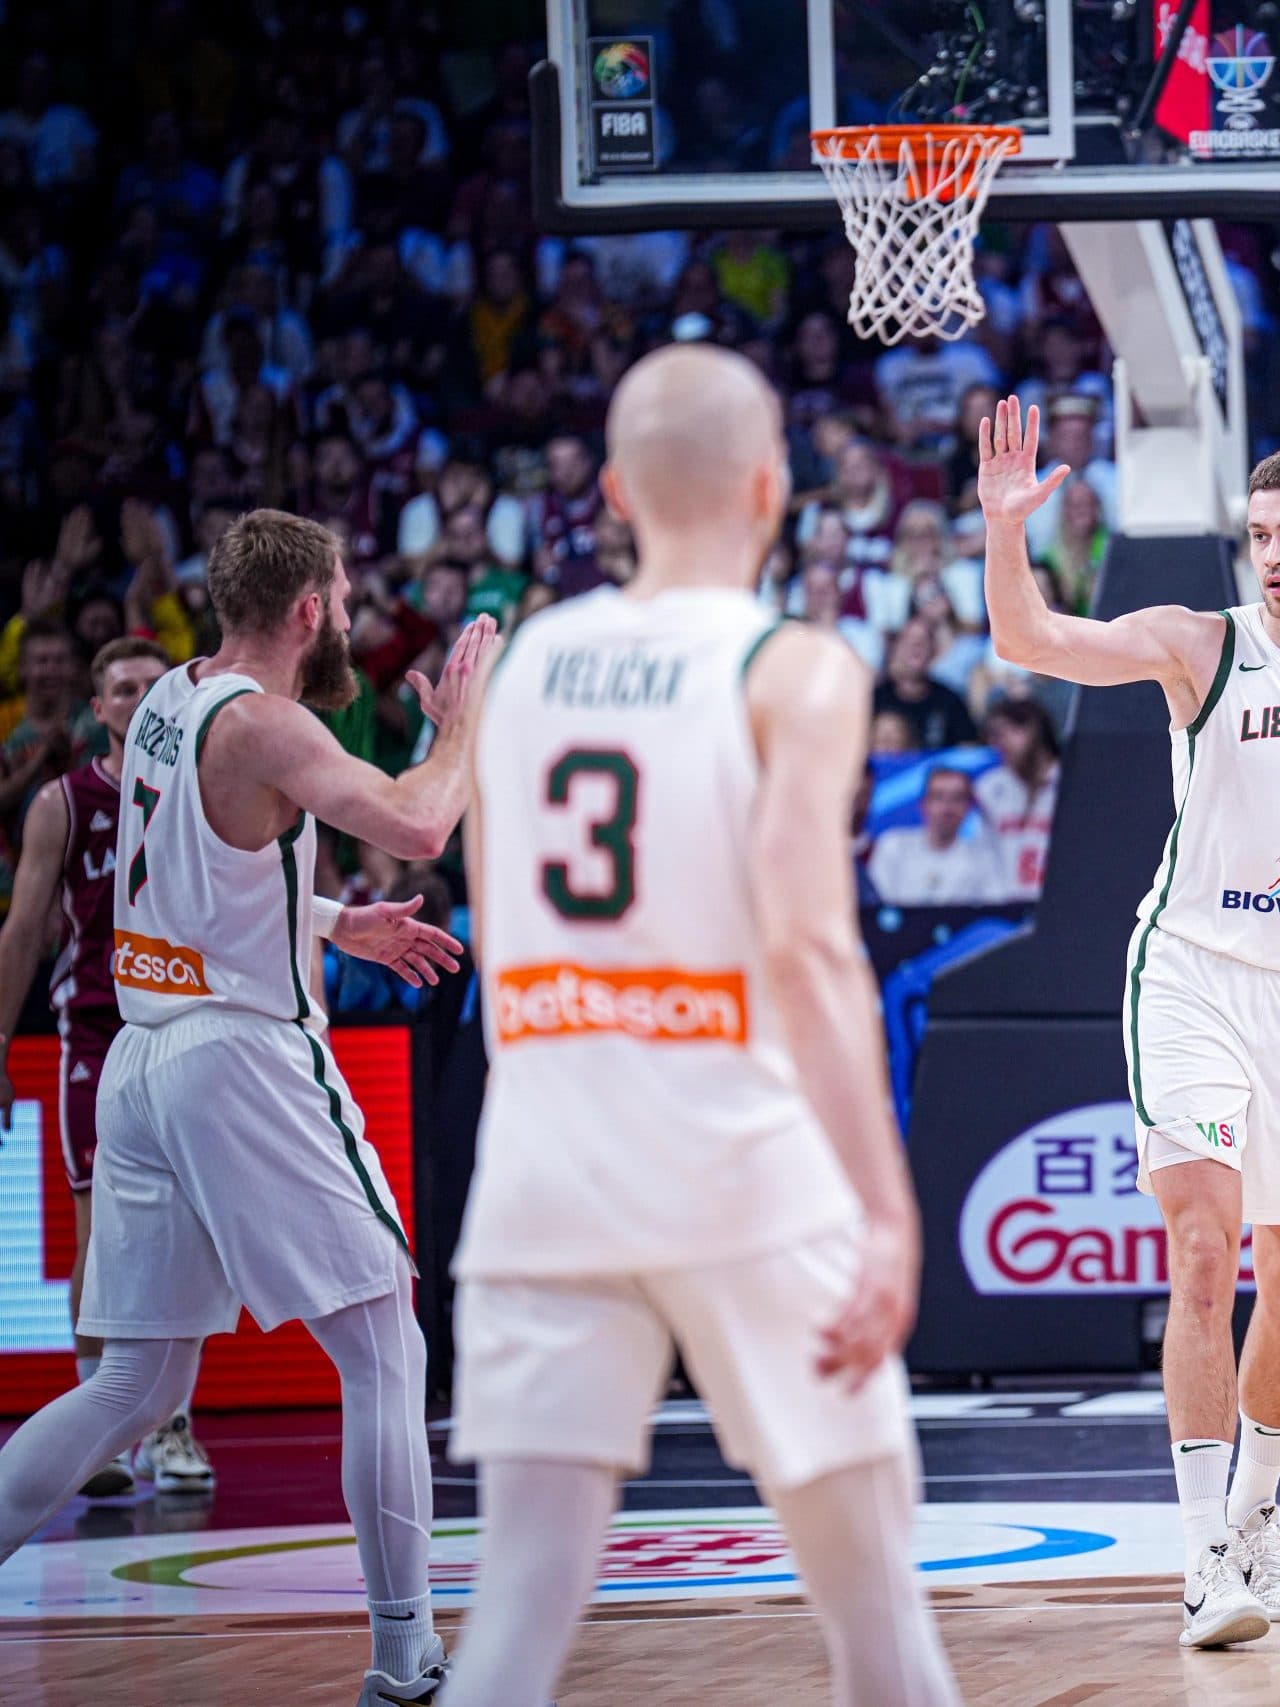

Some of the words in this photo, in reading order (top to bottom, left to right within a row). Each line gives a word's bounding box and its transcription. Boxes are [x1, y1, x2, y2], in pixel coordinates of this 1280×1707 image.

[601, 112, 647, 136] FIBA
[128, 776, 161, 907] 7
[538, 743, 643, 928] 3
[116, 942, 201, 987] tsson
